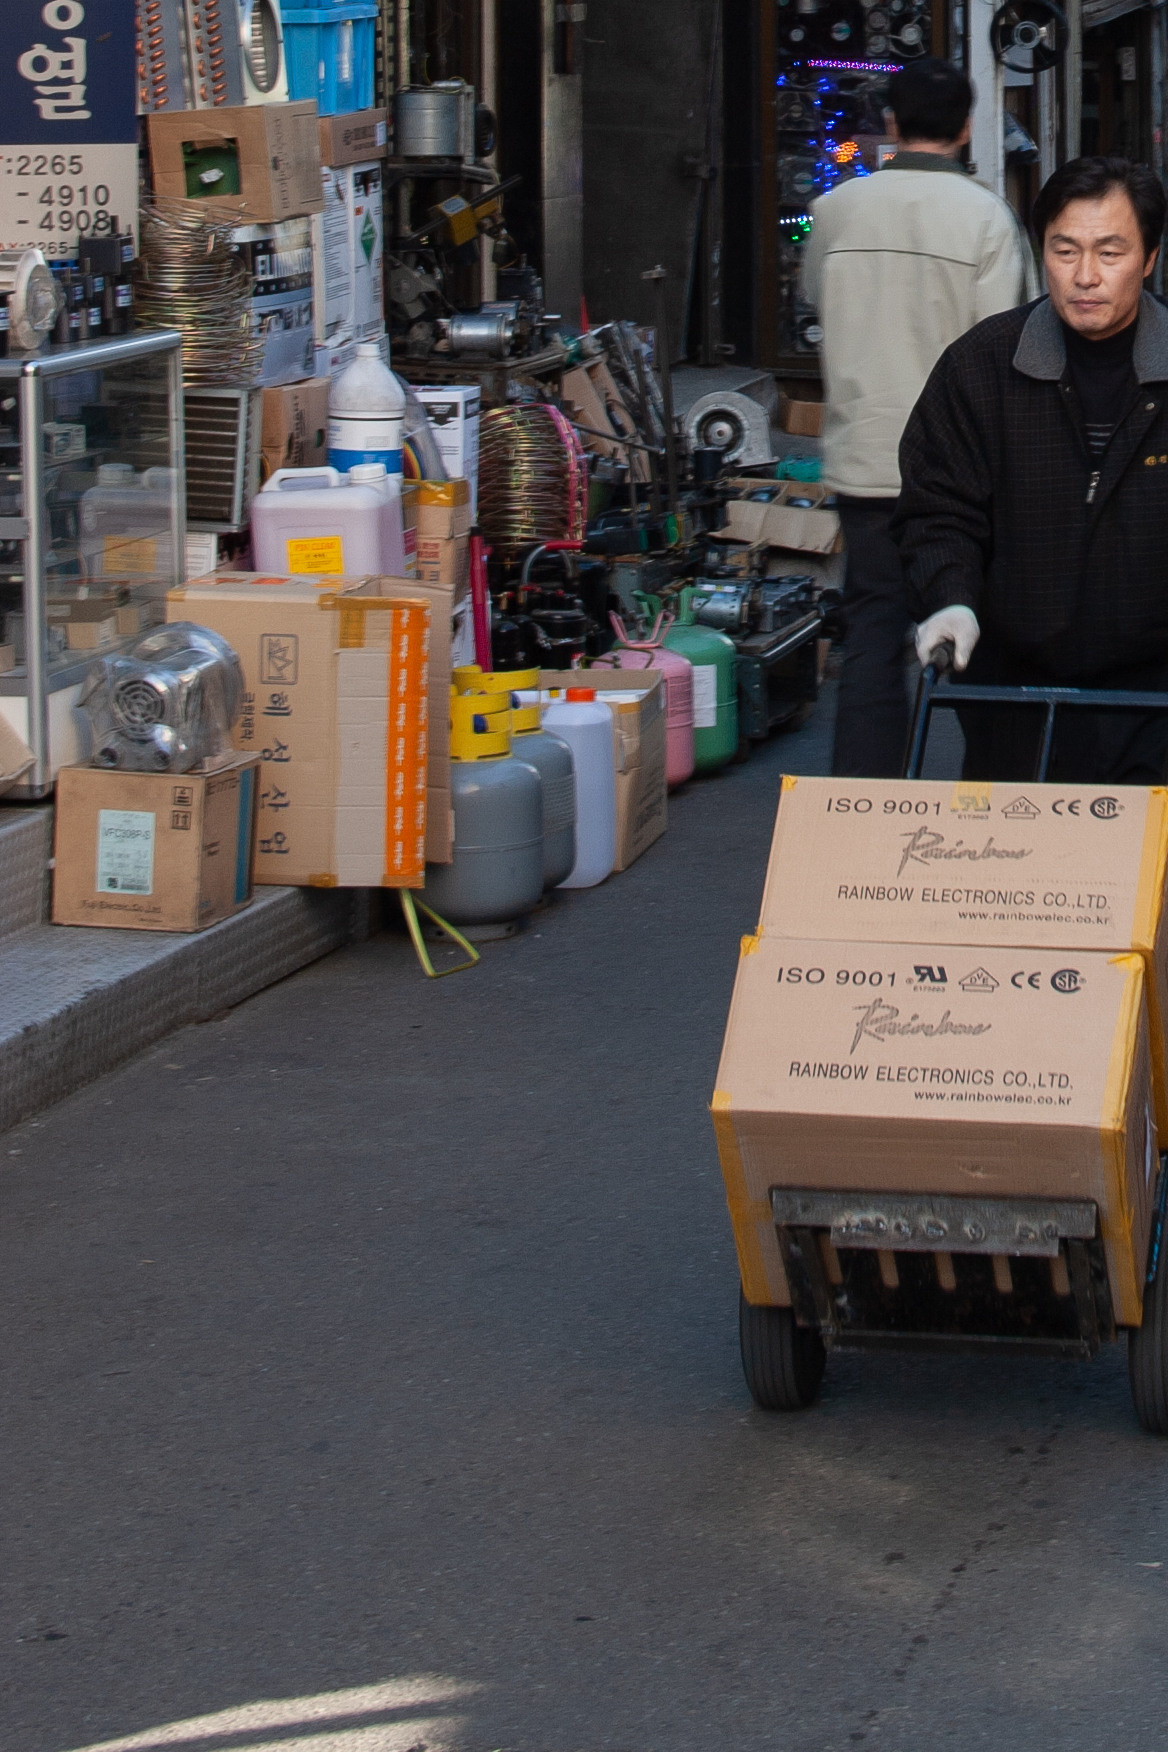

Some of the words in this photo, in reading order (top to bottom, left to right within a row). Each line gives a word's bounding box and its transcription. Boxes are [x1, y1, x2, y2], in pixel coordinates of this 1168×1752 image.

[0, 155, 83, 175] :2265
[826, 797, 872, 814] ISO
[883, 799, 942, 817] 9001
[838, 885, 914, 902] RAINBOW
[922, 887, 1035, 907] ELECTRONICS
[1044, 892, 1111, 910] CO.,LTD.
[958, 910, 1109, 925] www.rainbowelec.co.kr
[777, 967, 825, 984] ISO
[835, 969, 896, 987] 9001
[789, 1062, 868, 1080] RAINBOW
[876, 1065, 994, 1087] ELECTRONICS
[1003, 1071, 1074, 1090] CO.,LTD.
[914, 1090, 1072, 1107] www.rainbowelec.co.kr
